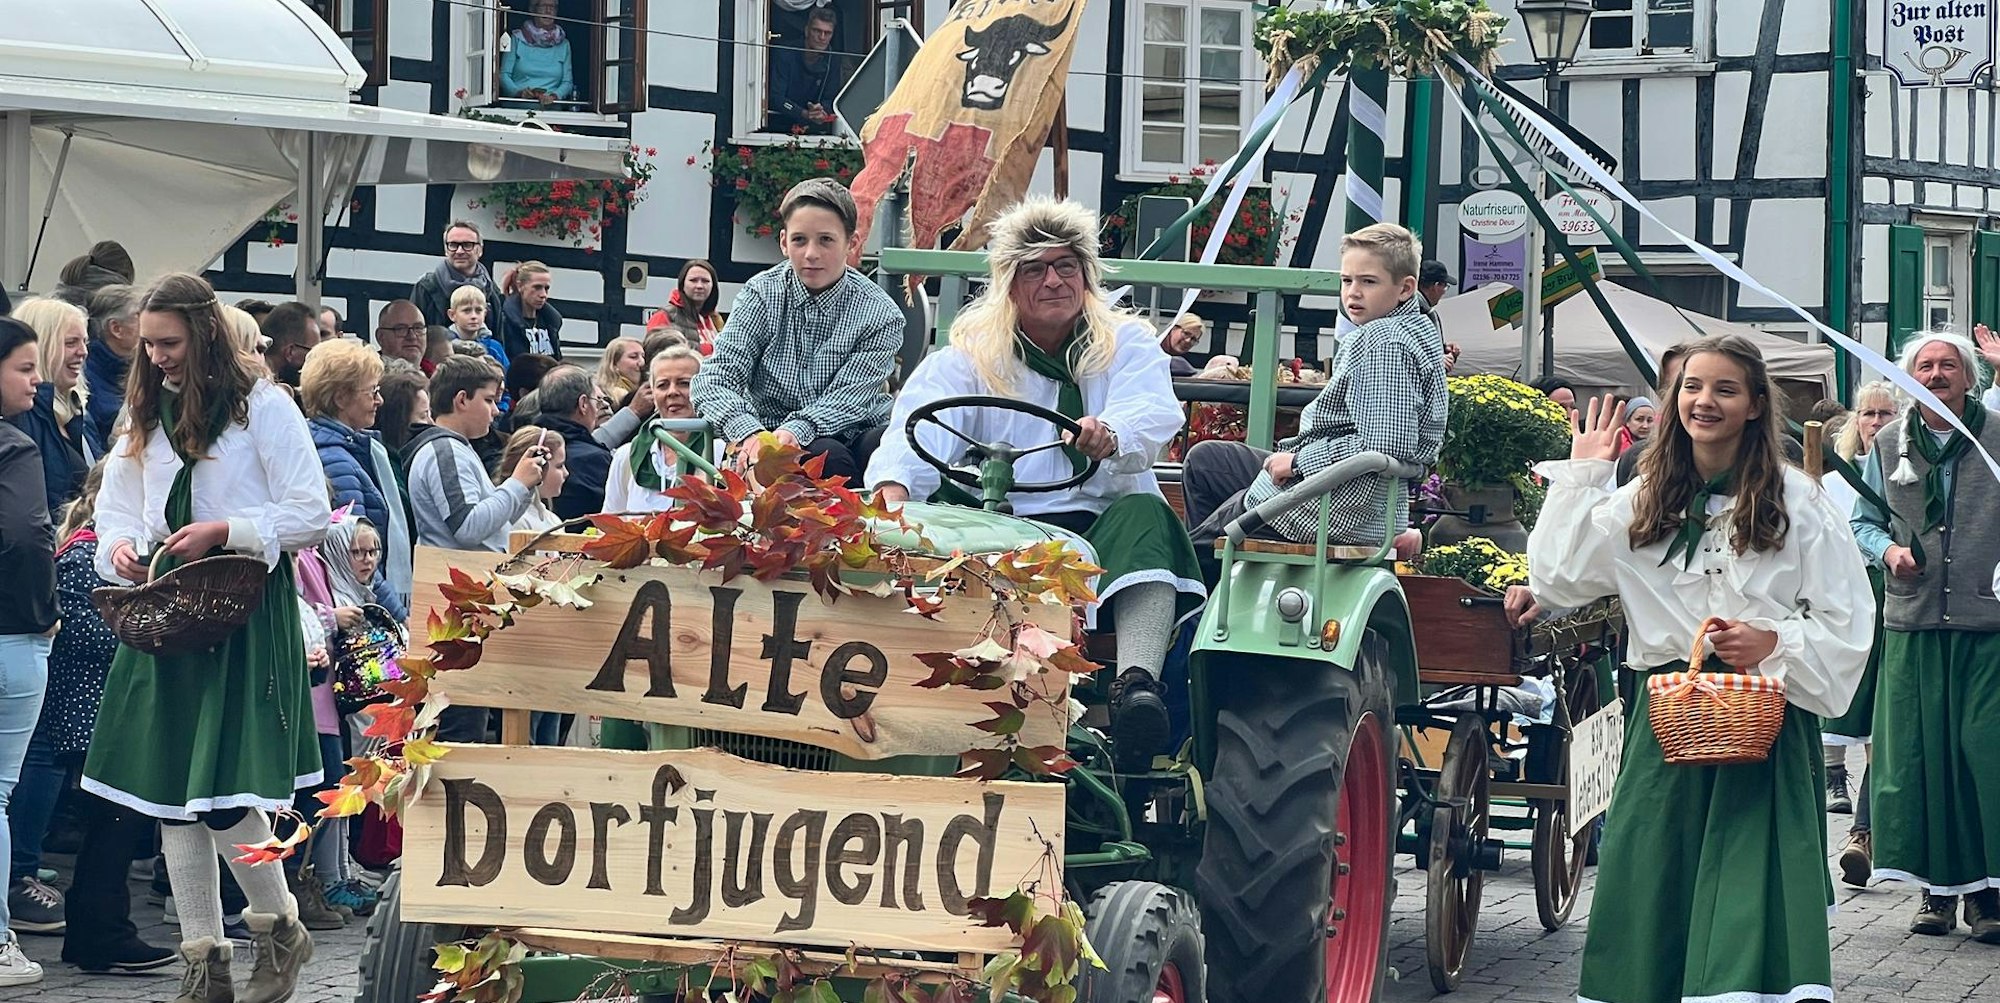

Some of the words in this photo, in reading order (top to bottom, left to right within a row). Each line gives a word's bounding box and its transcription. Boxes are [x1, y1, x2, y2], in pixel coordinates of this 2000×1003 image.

[1890, 2, 1931, 27] Zur
[1936, 0, 1986, 19] alten
[1913, 24, 1966, 50] Post
[1462, 203, 1526, 217] Naturfriseurin
[1560, 220, 1596, 232] 39633
[585, 578, 890, 720] Alte
[435, 764, 1005, 933] Dorfjugend
